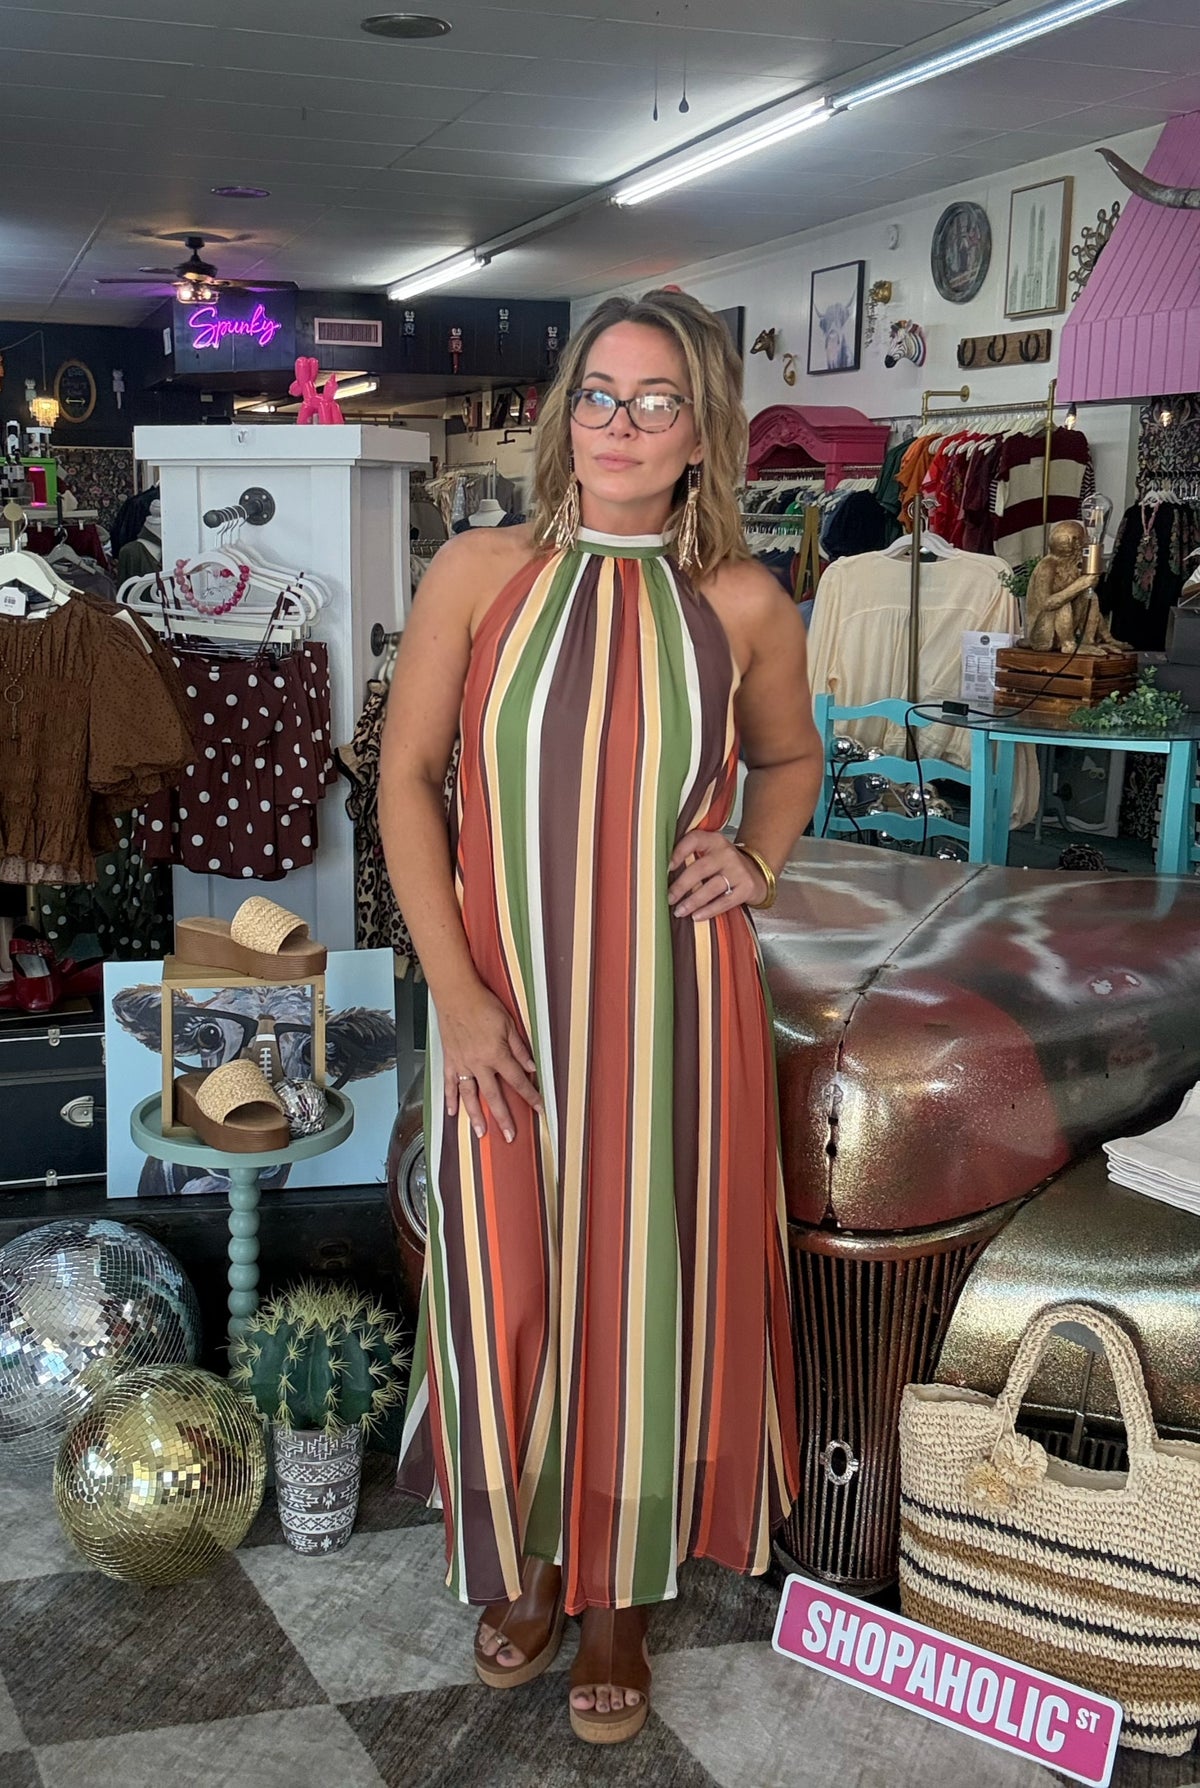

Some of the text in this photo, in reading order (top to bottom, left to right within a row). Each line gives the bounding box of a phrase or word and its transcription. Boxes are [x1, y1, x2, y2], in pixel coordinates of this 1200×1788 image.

[189, 304, 282, 348] Spunky
[802, 1600, 1101, 1753] SHOPAHOLIC ST
